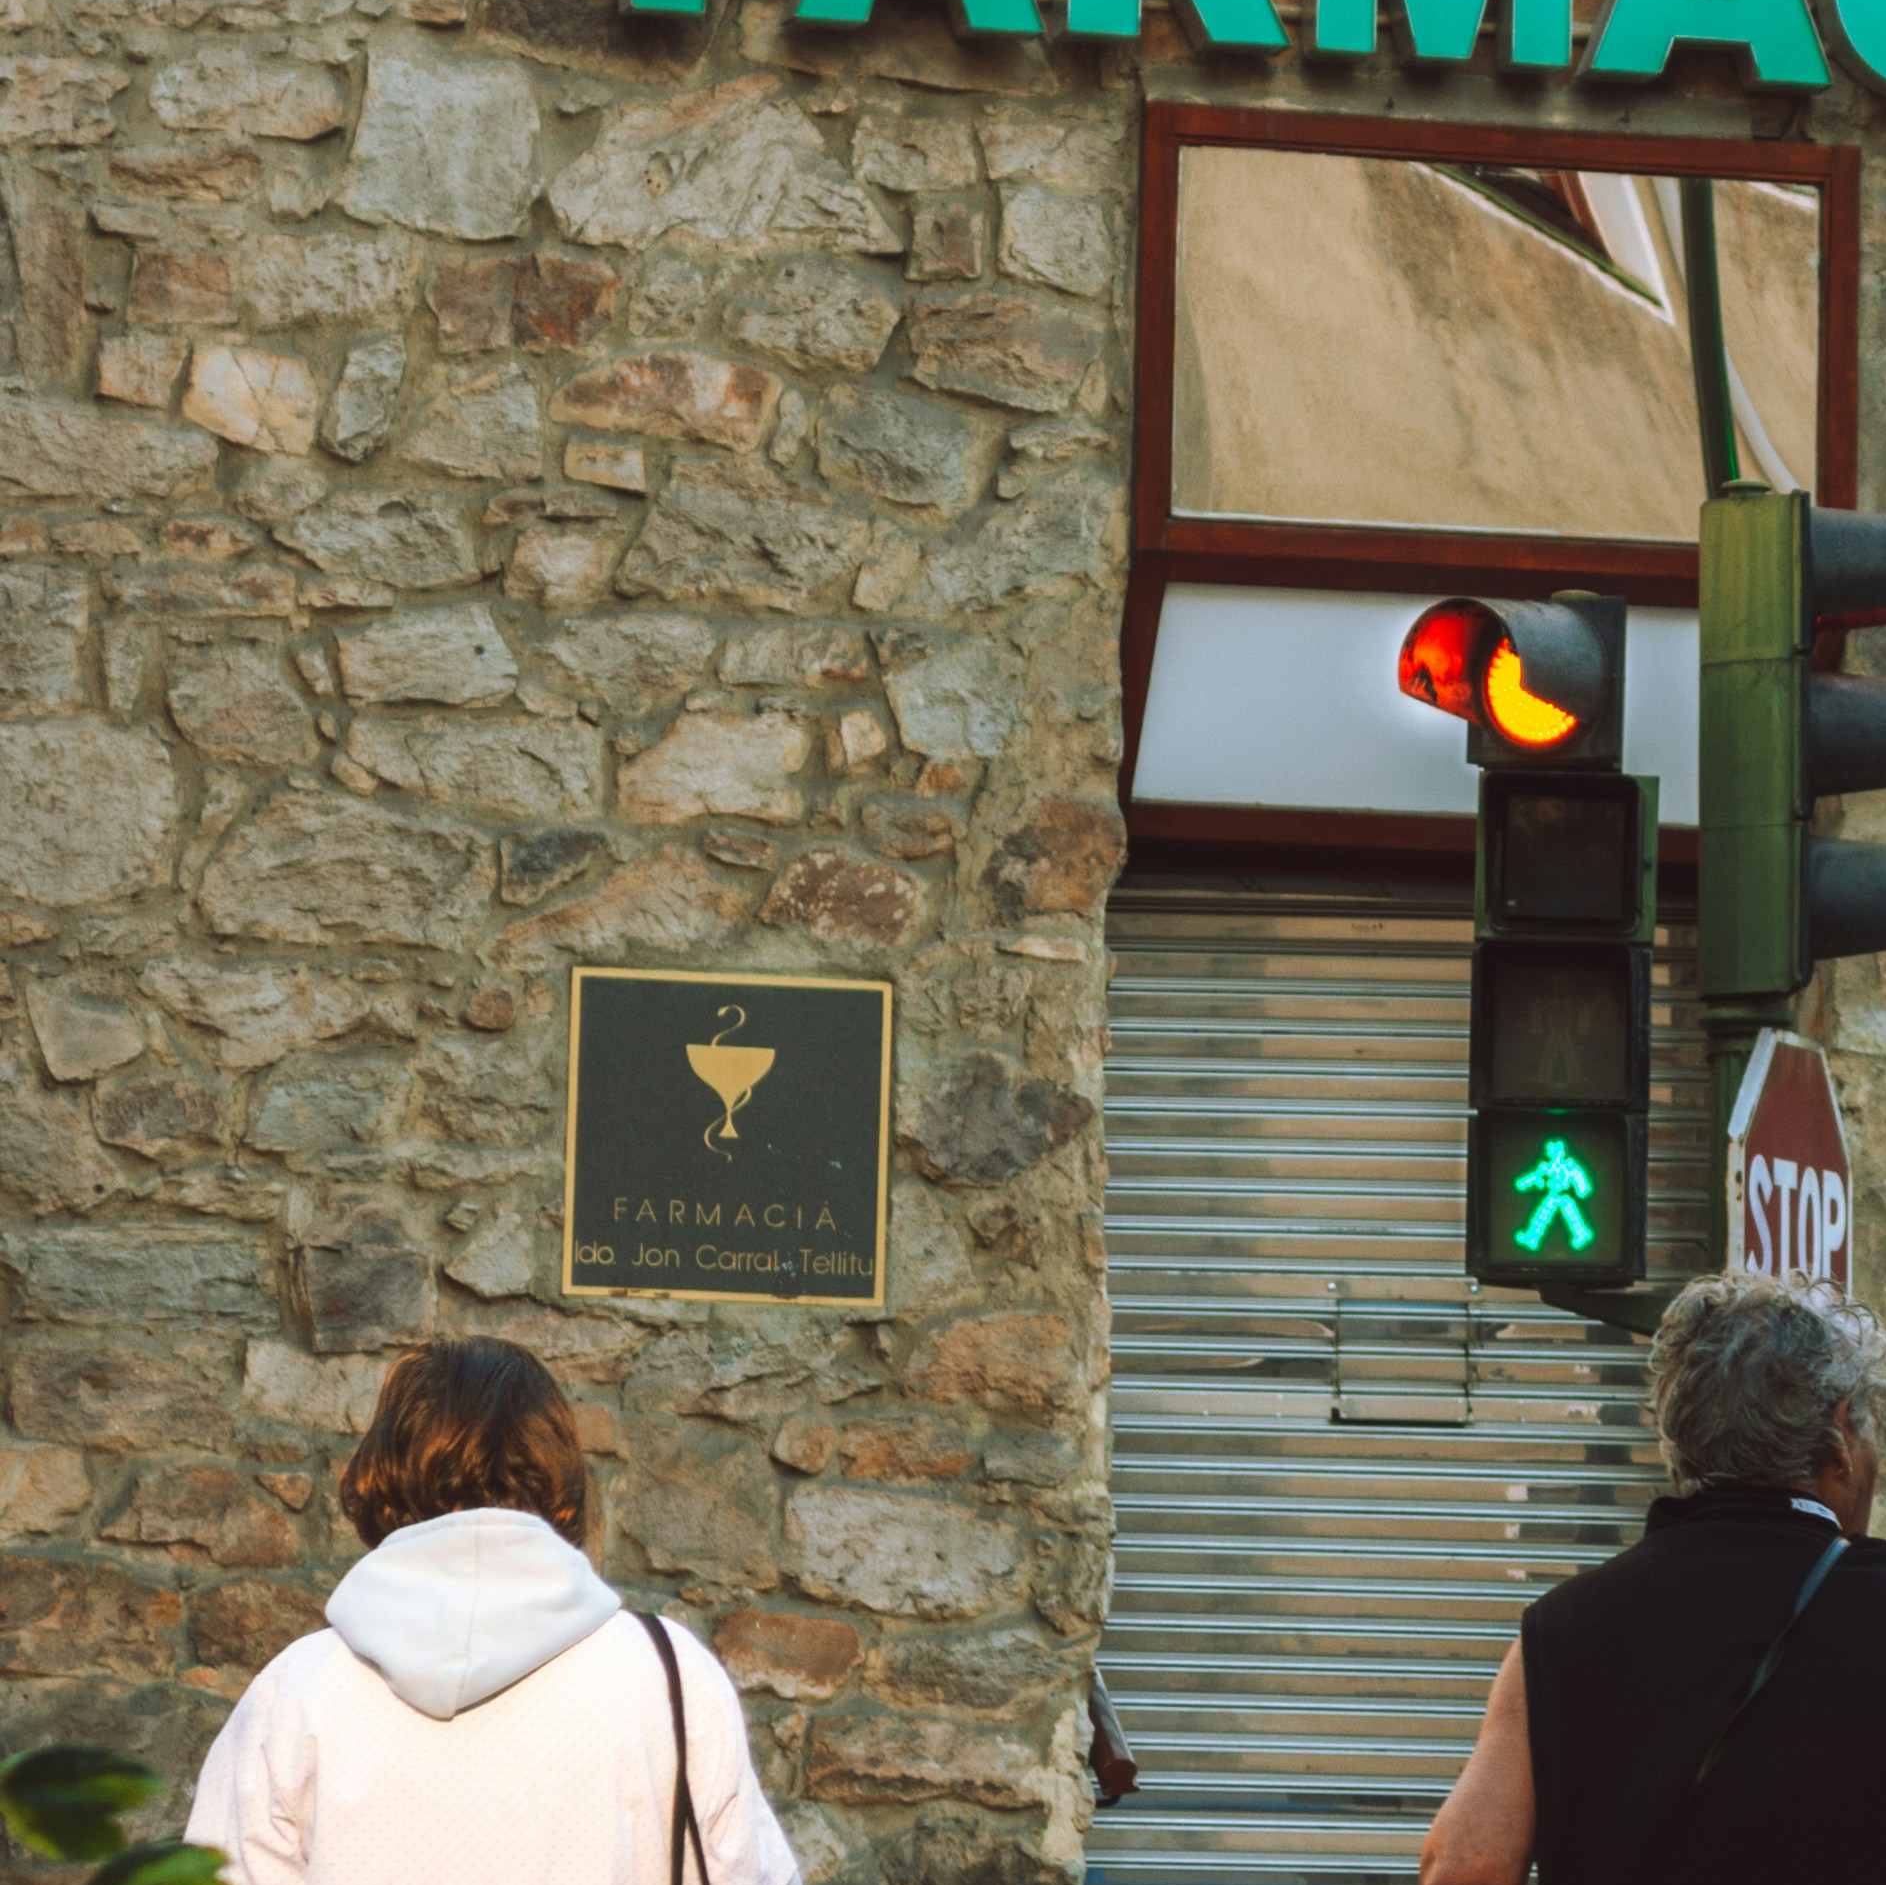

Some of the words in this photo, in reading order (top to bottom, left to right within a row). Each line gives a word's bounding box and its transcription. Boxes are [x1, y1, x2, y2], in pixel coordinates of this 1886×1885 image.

[614, 1197, 836, 1231] FARMACIA
[1747, 1154, 1846, 1287] STOP
[632, 1243, 680, 1267] Jon
[695, 1244, 779, 1272] Carral
